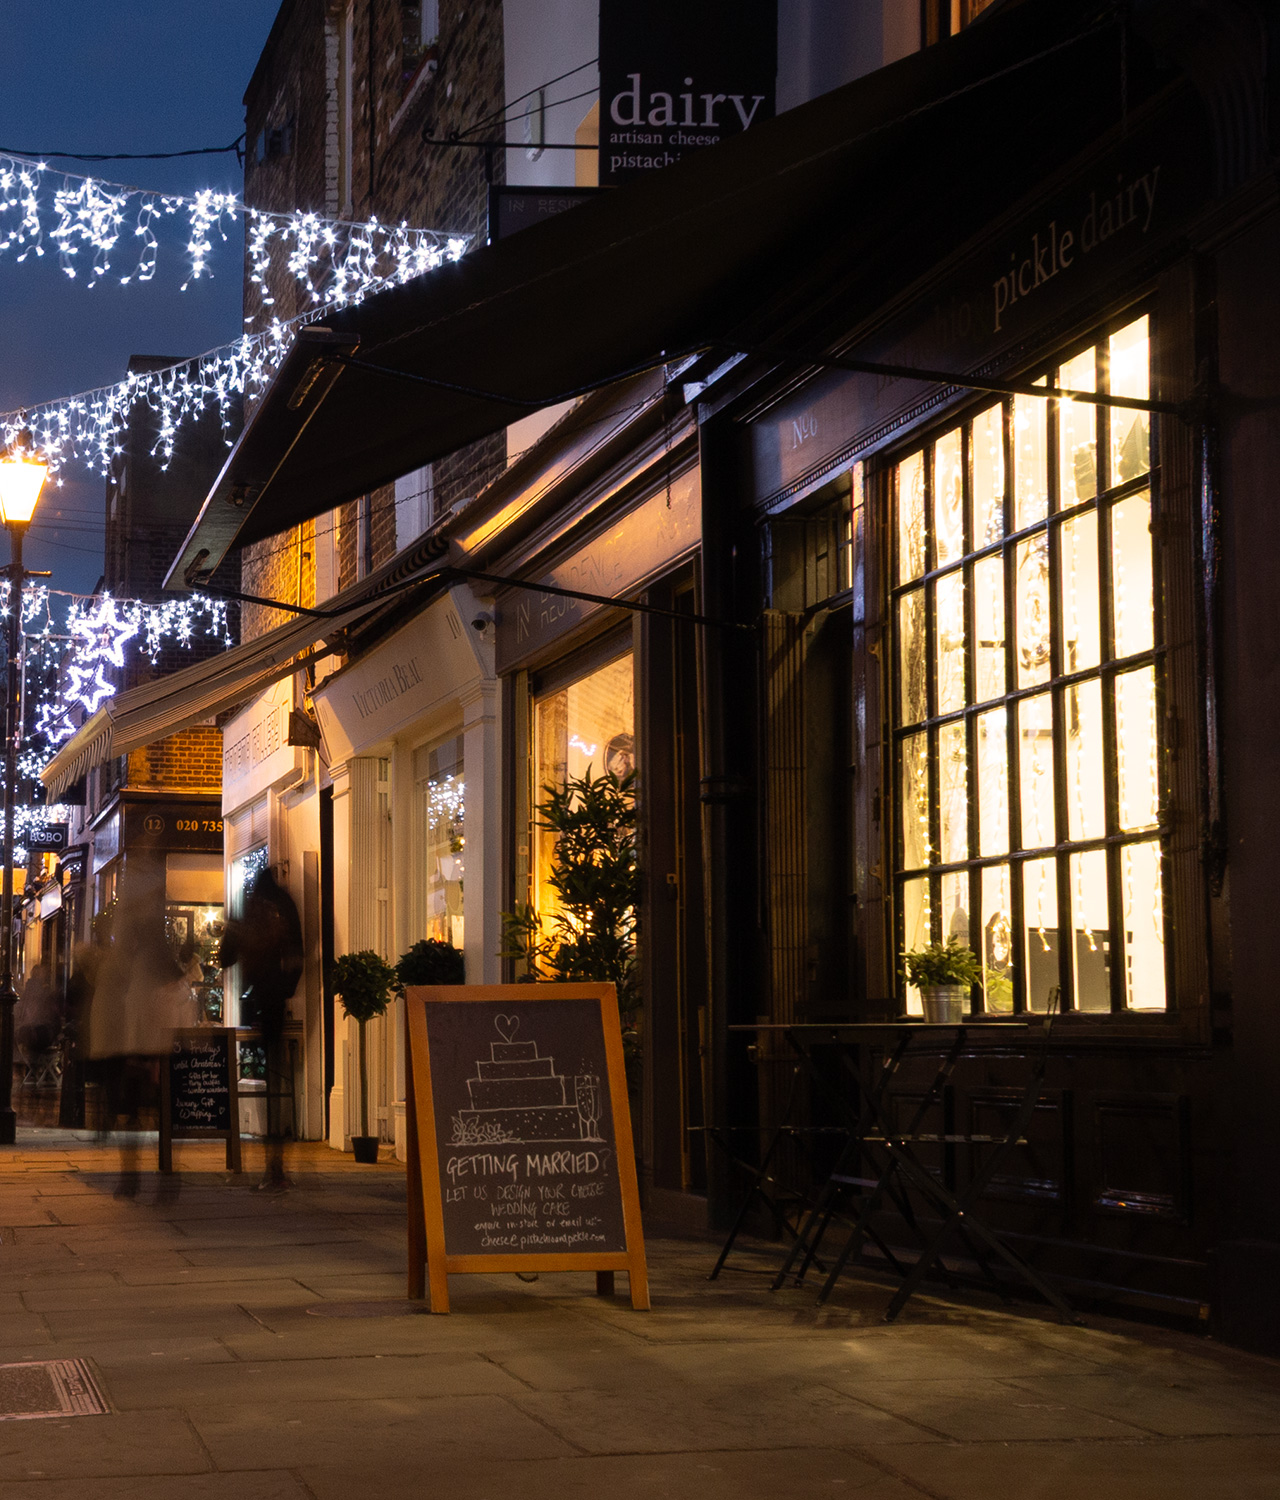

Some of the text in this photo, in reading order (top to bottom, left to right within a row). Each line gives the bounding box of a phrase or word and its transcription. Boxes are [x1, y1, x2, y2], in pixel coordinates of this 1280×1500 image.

[609, 73, 765, 132] dairy
[609, 130, 721, 146] artisan cheese
[609, 153, 682, 173] pistach
[508, 199, 525, 213] IN
[991, 220, 1075, 333] pickle
[1079, 164, 1162, 254] dairy
[445, 609, 462, 640] 10
[352, 674, 401, 720] VICTORIA
[148, 819, 224, 833] 12 020 735
[29, 831, 63, 843] BOBO
[189, 1039, 221, 1062] Fridays
[446, 1153, 519, 1185] GETTING
[446, 1186, 468, 1203] LET
[473, 1184, 488, 1201] US
[496, 1183, 531, 1203] DESIGN
[537, 1183, 566, 1199] YOUR
[490, 1201, 571, 1219] WEDDING CAKE
[546, 1219, 556, 1228] or
[559, 1215, 582, 1227] email
